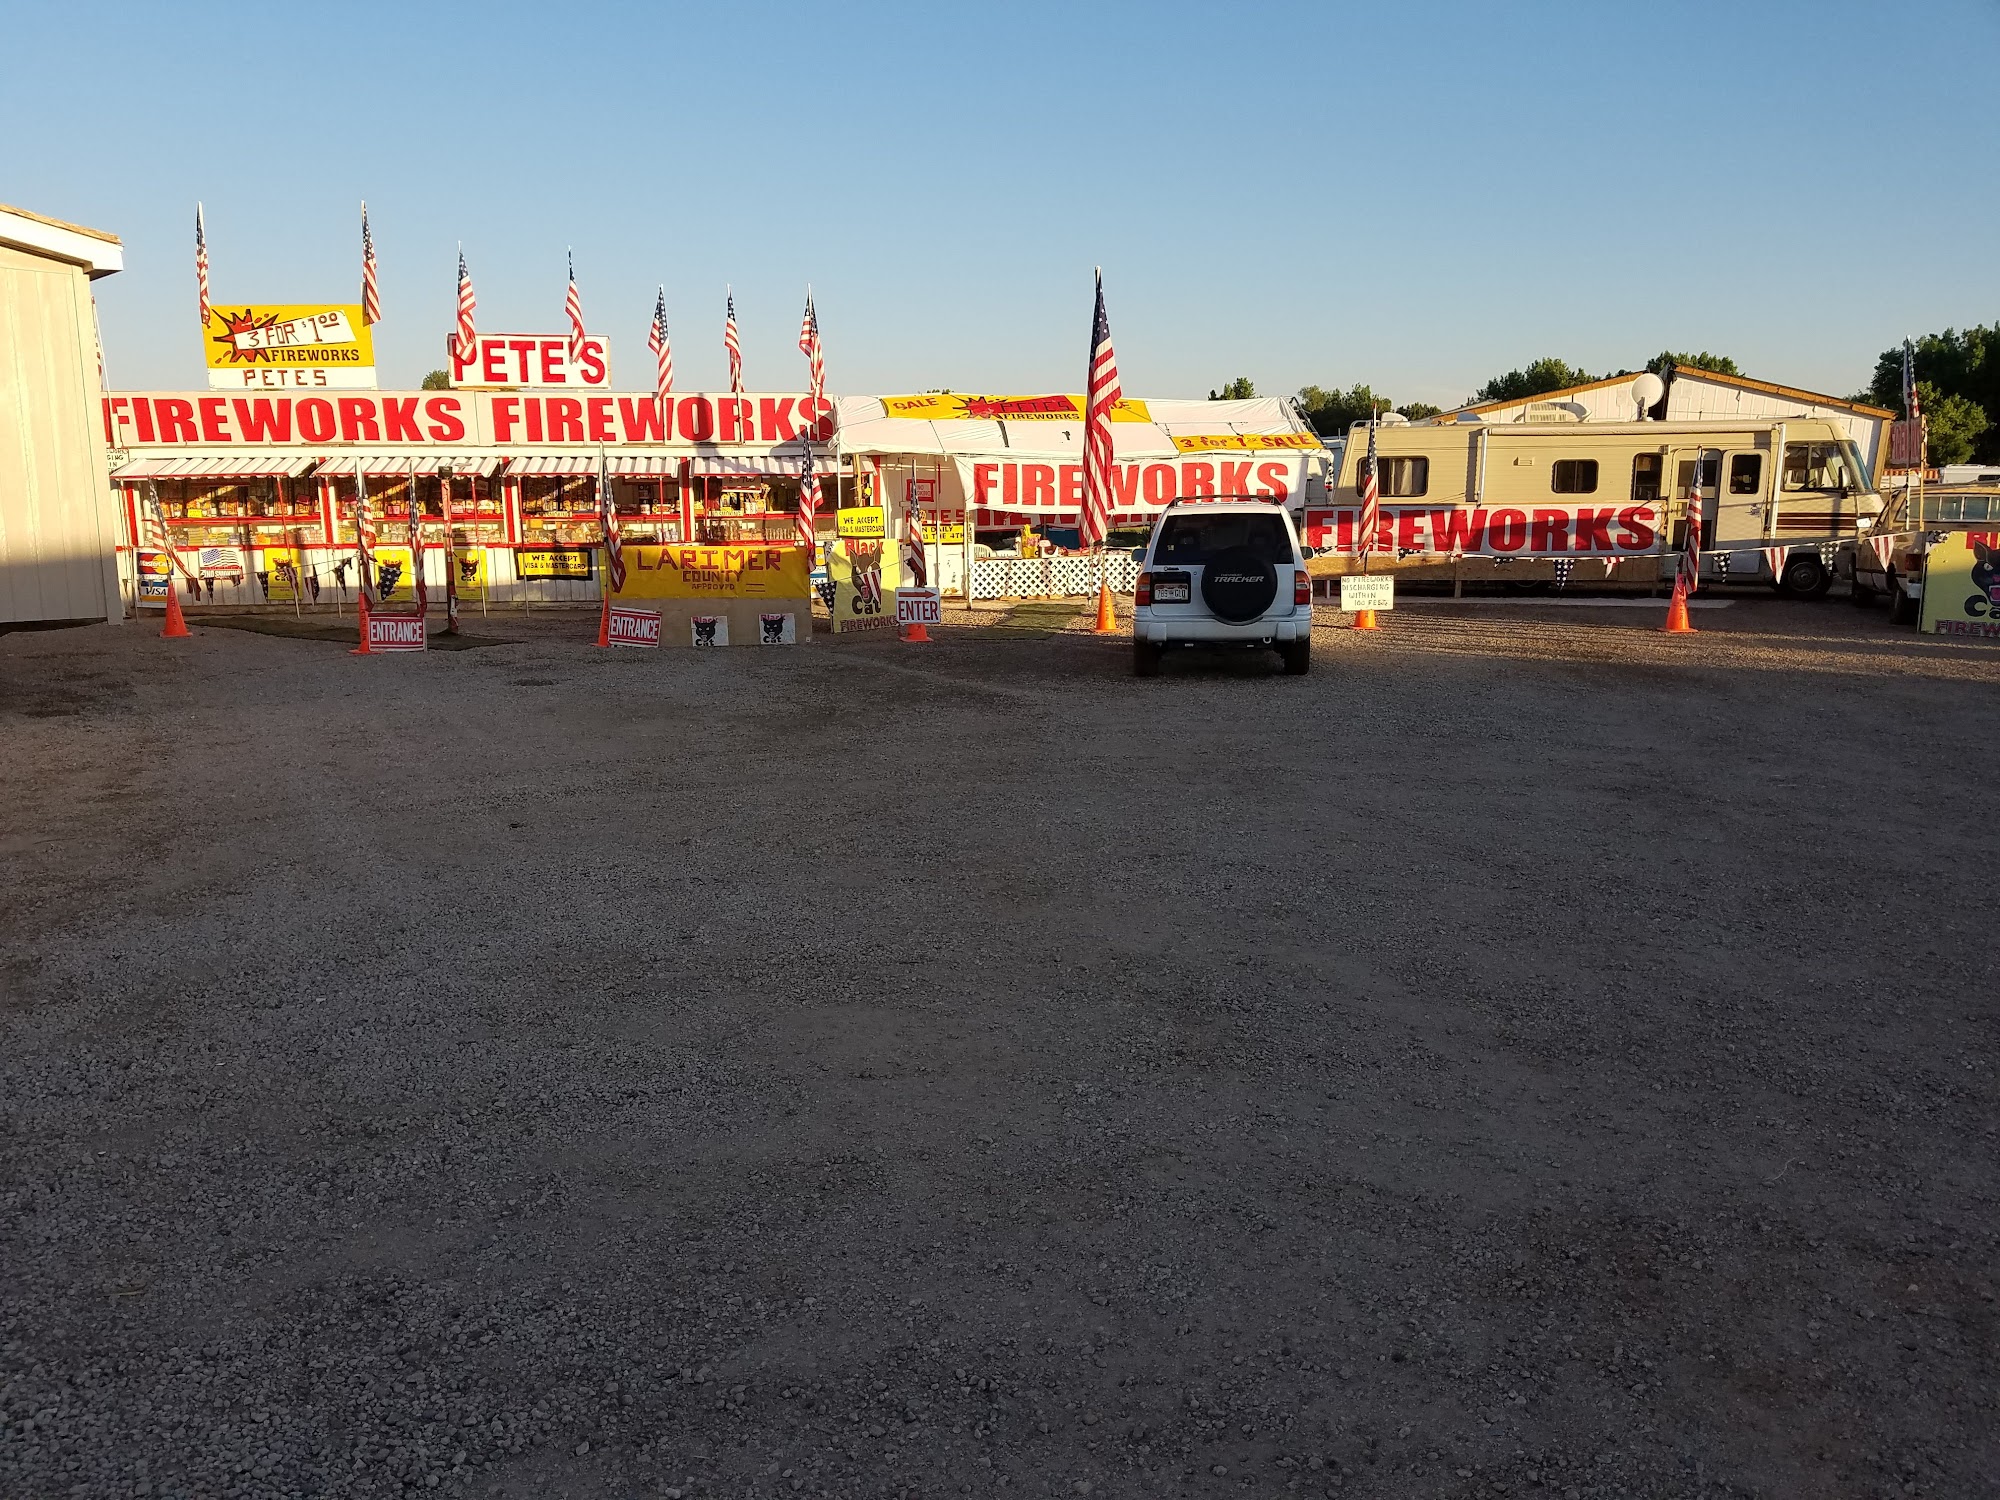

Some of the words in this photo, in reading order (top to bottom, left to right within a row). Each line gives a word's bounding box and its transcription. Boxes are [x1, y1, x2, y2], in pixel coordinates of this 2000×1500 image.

[247, 331, 260, 347] 3
[265, 323, 299, 345] FOR
[271, 349, 360, 362] FIREWORKS
[451, 338, 606, 385] PETE'S
[243, 369, 327, 386] PETES
[892, 398, 940, 411] SALE
[1000, 398, 1070, 412] PETES
[101, 396, 465, 443] FIREWORKS
[491, 396, 834, 443] FIREWORKS
[1179, 438, 1195, 448] 3
[1200, 436, 1228, 447] for
[1260, 434, 1313, 448] SALE
[973, 461, 1289, 506] FIREWORKS
[843, 517, 854, 525] WE
[857, 516, 879, 524] ACCEPT
[906, 509, 964, 524] PTES
[855, 525, 885, 533] MASTERCARD
[1306, 507, 1656, 552] FIREWORKS
[844, 539, 885, 556] Black
[637, 548, 782, 571] LARIMER
[682, 570, 744, 582] COUNTY
[146, 586, 167, 595] VISA
[852, 596, 881, 615] Cat
[899, 601, 939, 621] ENTER
[611, 616, 659, 640] ENTRANCE
[840, 614, 898, 631] FIREWORKS
[370, 621, 423, 642] ENTRANCE
[763, 635, 782, 643] Cat
